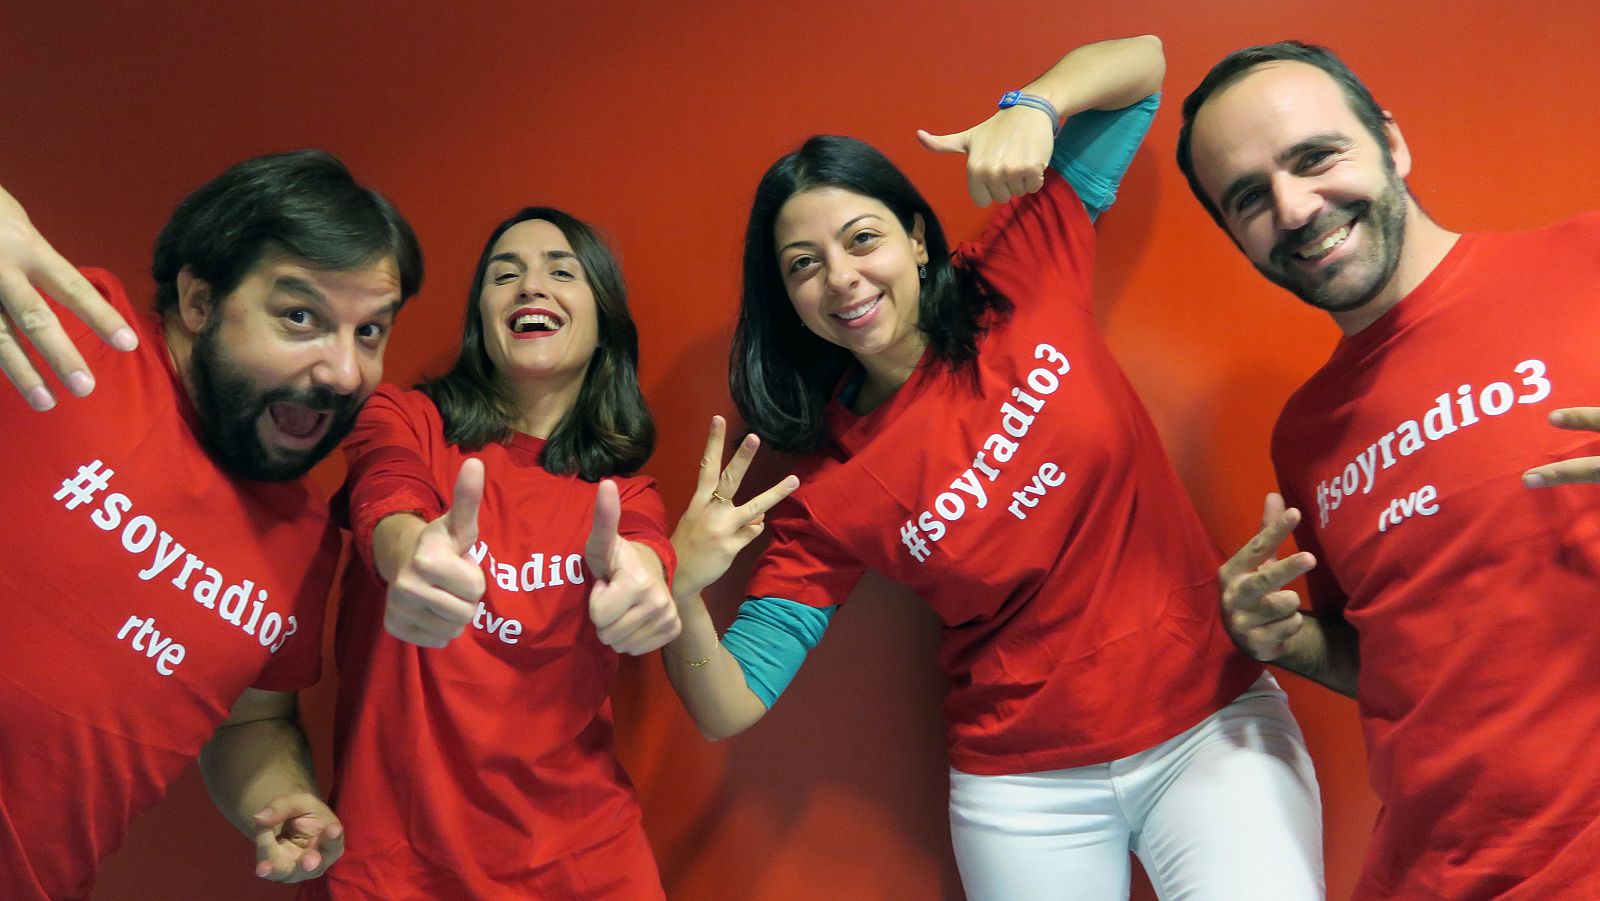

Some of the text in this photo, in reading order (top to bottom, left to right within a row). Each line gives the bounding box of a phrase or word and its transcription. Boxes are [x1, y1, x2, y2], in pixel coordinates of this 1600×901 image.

[900, 343, 1071, 563] #soyradio3
[1316, 359, 1551, 529] #soyradio3
[1007, 462, 1067, 520] rtve
[1378, 484, 1440, 532] rtve
[53, 459, 299, 653] #soyradio3
[116, 615, 186, 676] rtve
[472, 601, 523, 644] tve
